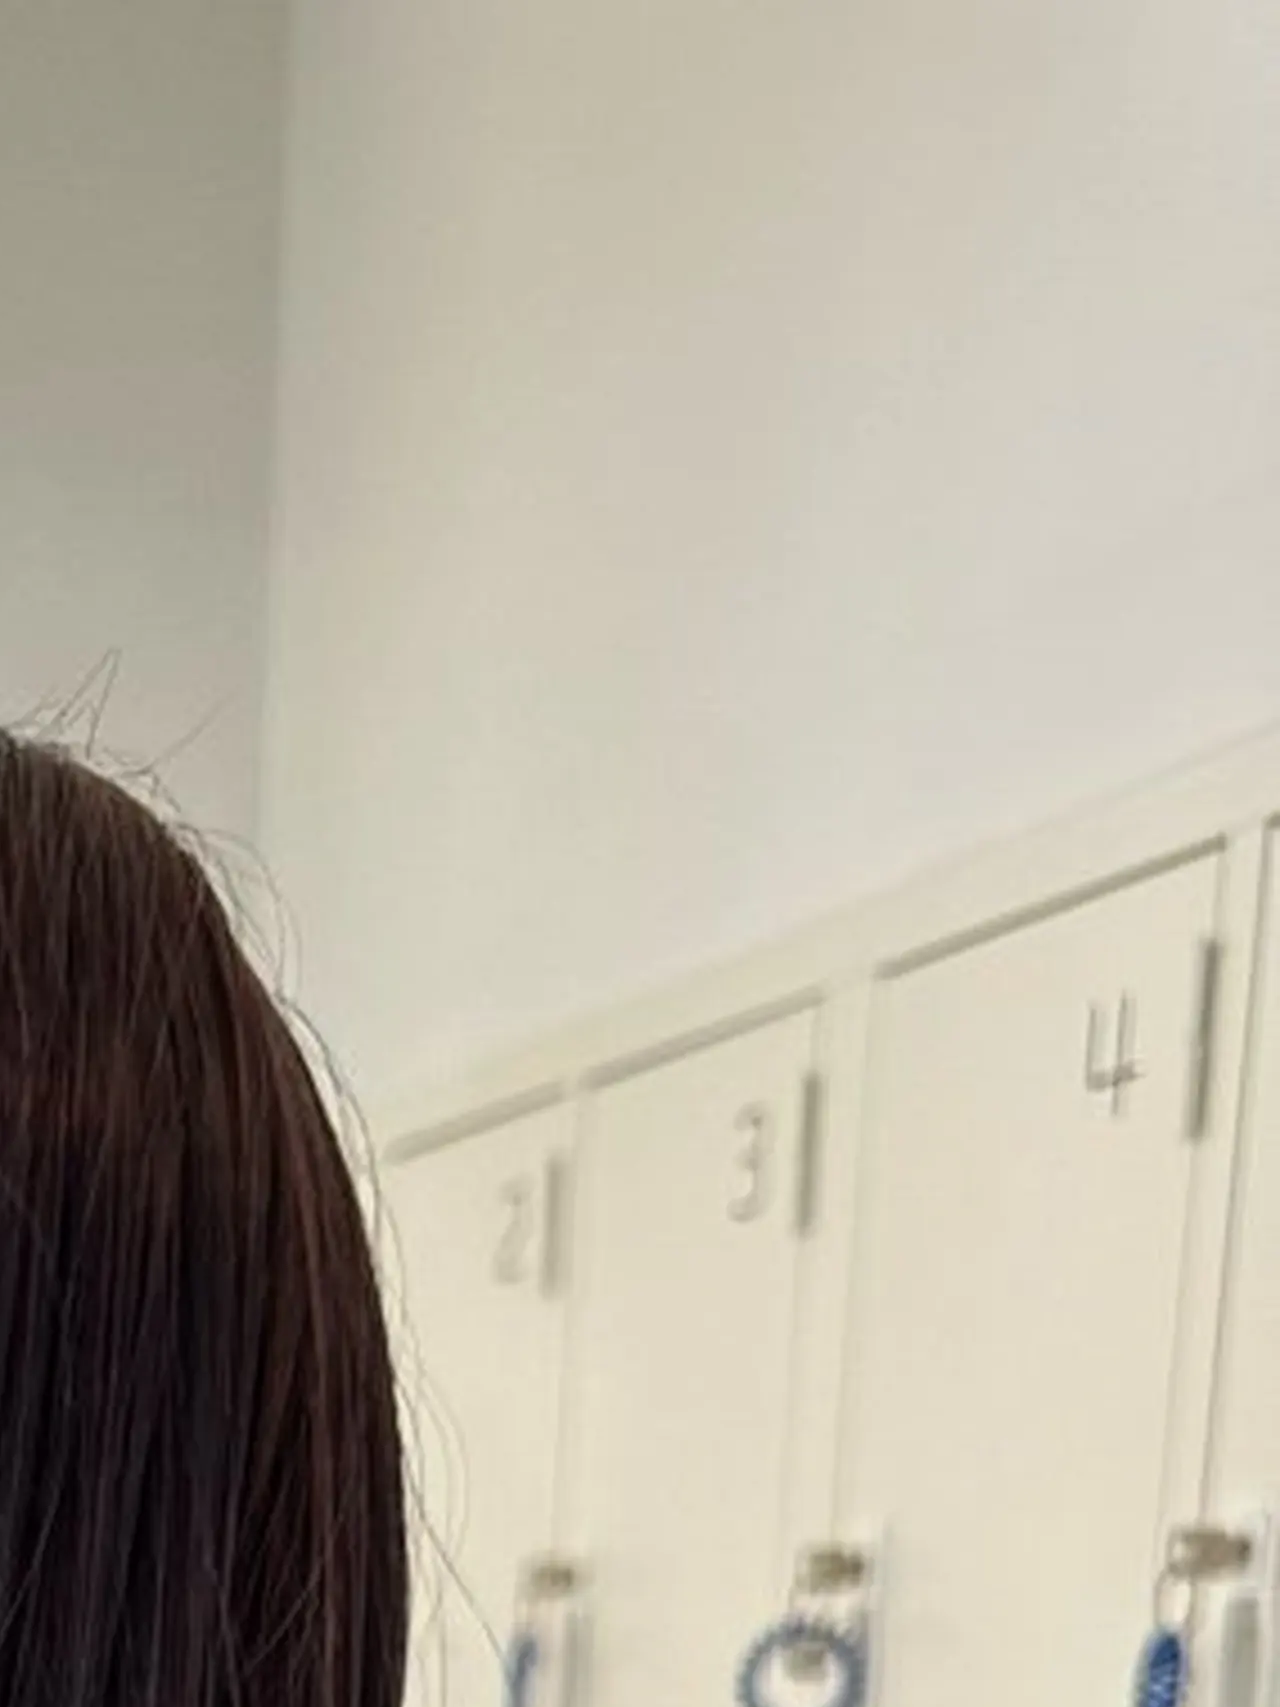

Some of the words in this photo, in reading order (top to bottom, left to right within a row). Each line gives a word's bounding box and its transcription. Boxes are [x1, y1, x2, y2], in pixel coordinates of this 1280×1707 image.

[1085, 990, 1148, 1118] 4
[726, 1100, 776, 1223] 3
[492, 1174, 535, 1286] 2
